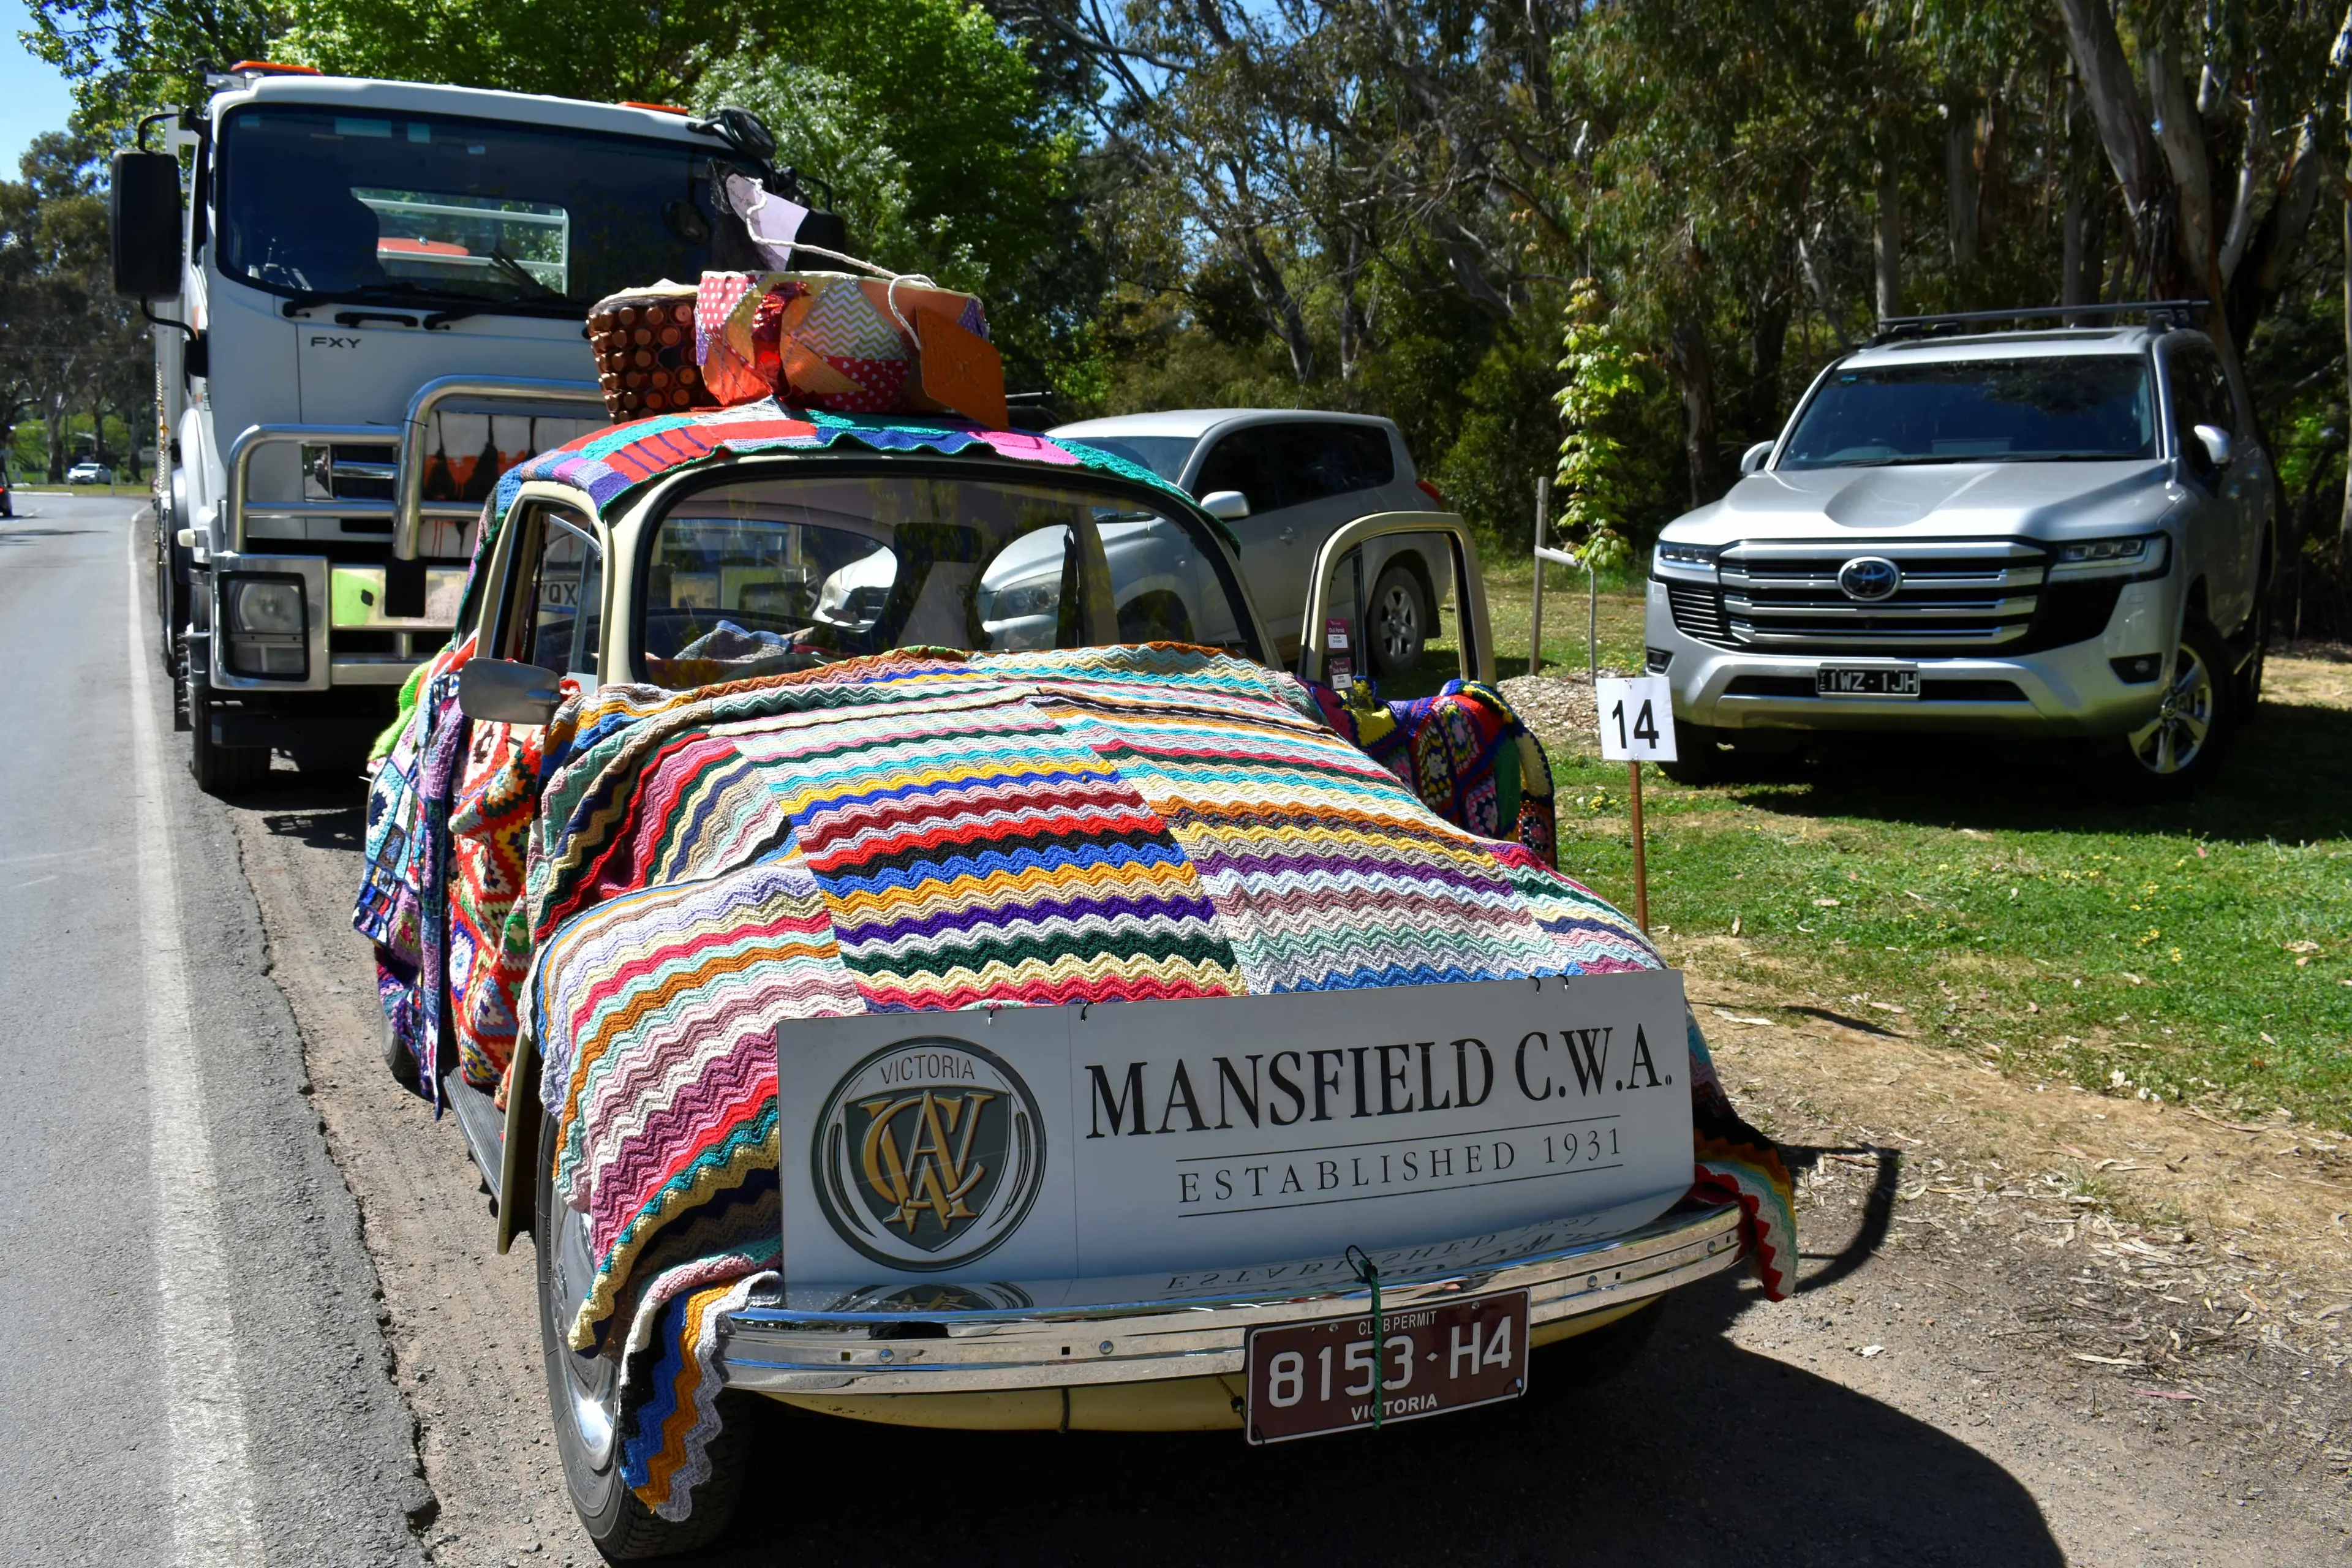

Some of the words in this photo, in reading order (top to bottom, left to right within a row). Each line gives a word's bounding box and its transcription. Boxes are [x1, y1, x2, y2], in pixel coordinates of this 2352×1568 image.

[311, 337, 361, 349] FXY
[1611, 699, 1660, 749] 14
[880, 1054, 976, 1085] VICTORIA
[1085, 1038, 1494, 1139] MANSFIELD
[1515, 1023, 1672, 1101] C.W.A.
[1178, 1141, 1515, 1204] ESTABLISHED
[1543, 1128, 1621, 1164] 1931
[1359, 1317, 1391, 1336] CLB
[1393, 1311, 1437, 1332] PERMIT
[1268, 1335, 1414, 1408] 8153
[1449, 1315, 1512, 1380] H4
